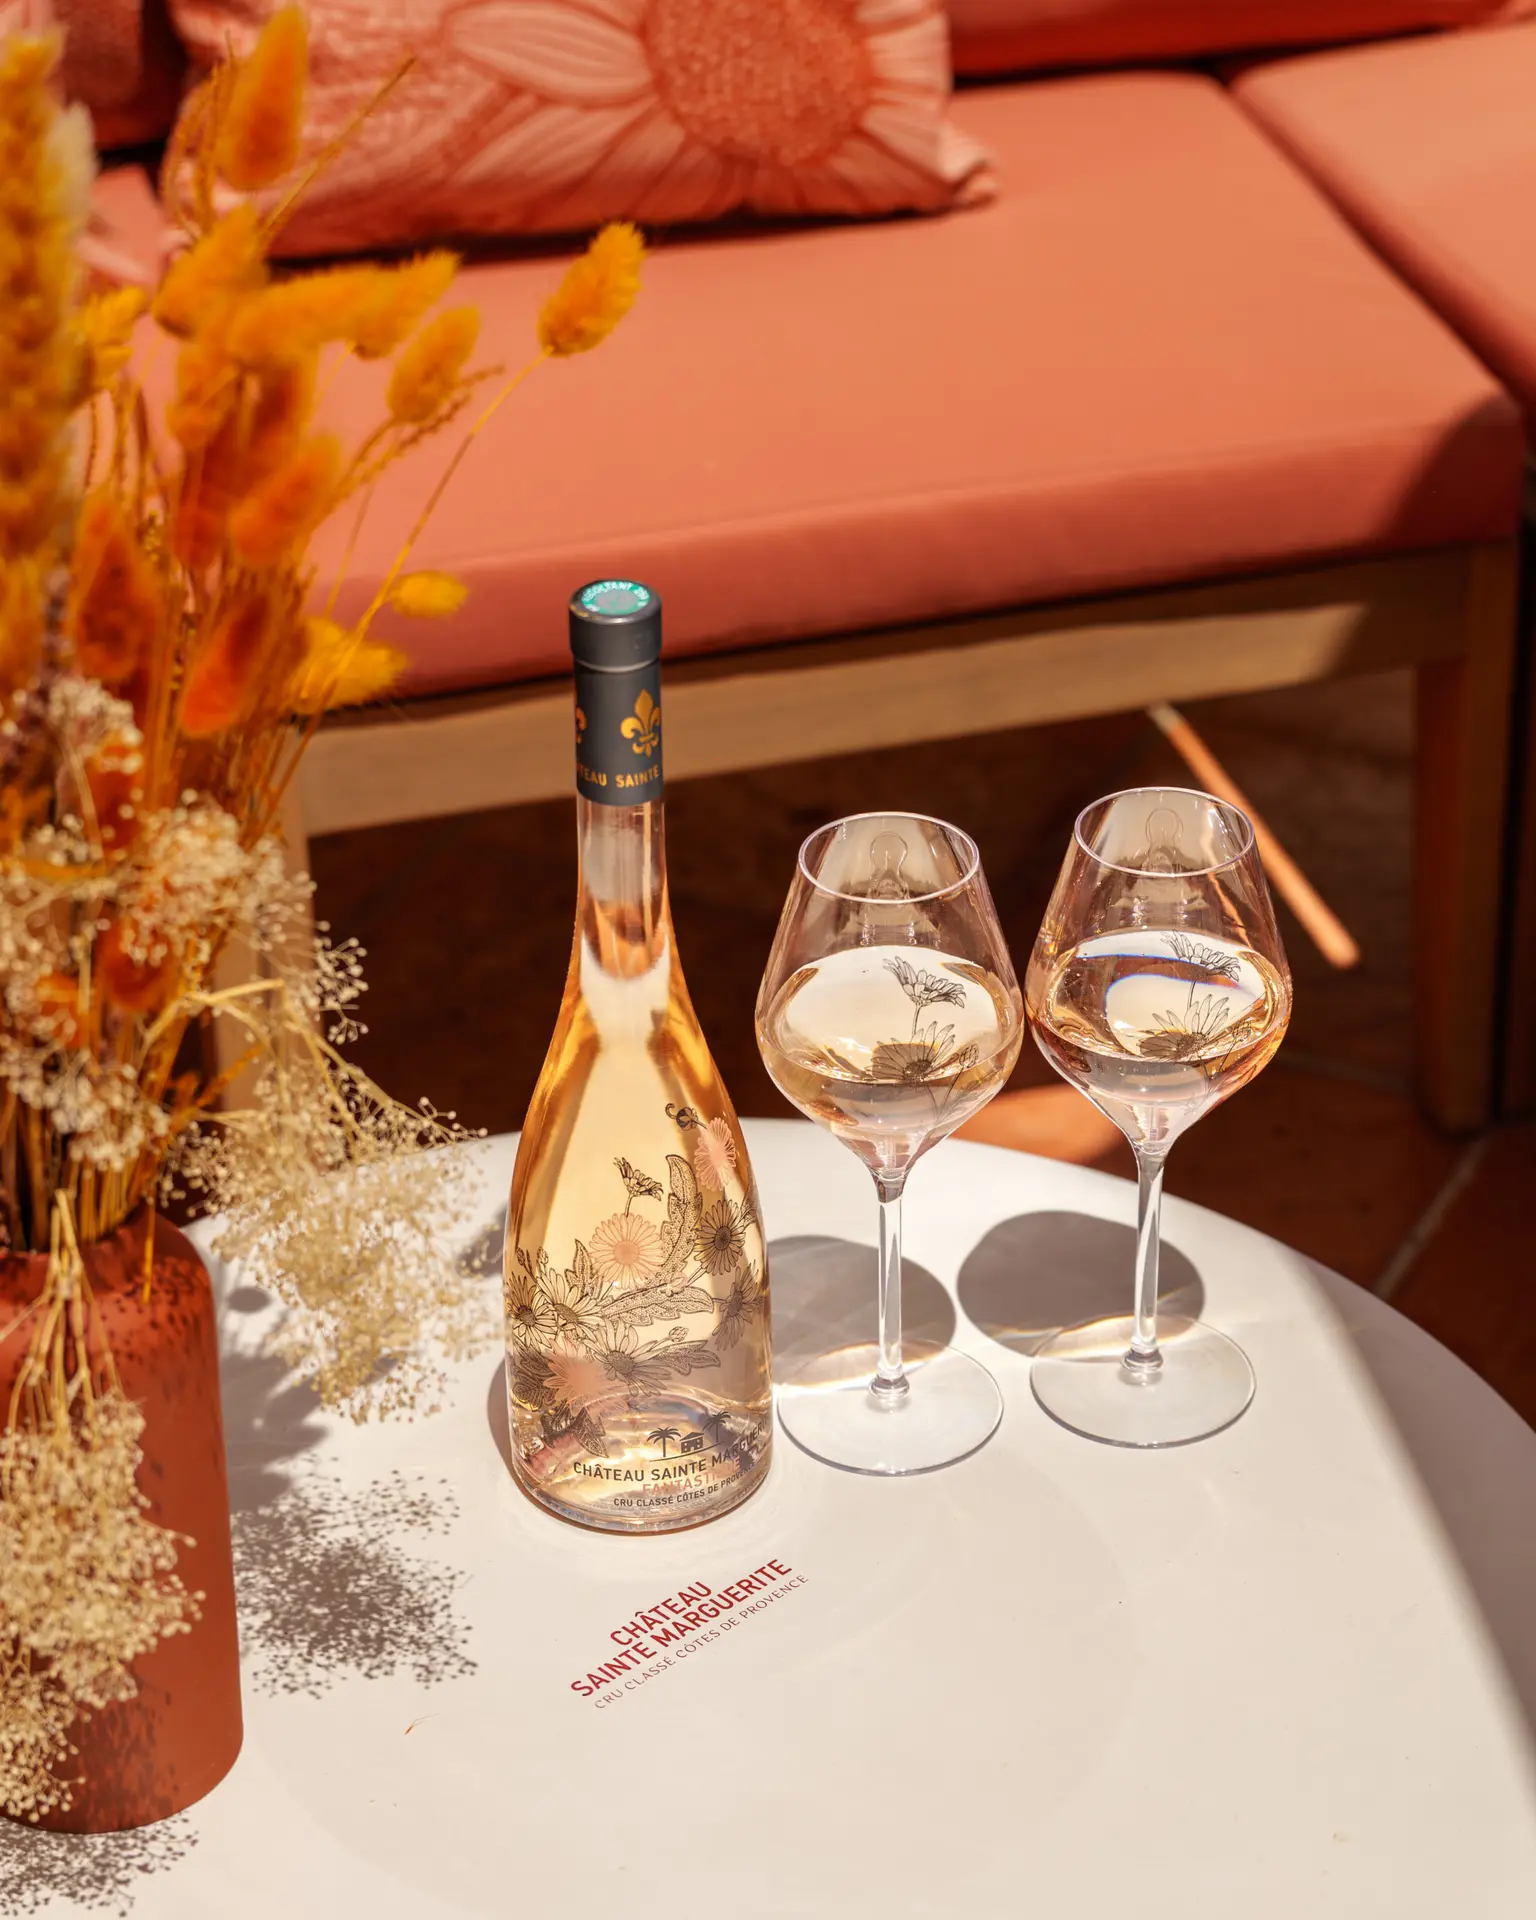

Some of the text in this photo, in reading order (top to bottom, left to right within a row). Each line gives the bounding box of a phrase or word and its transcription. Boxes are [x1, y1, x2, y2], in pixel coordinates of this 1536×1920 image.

[615, 764, 659, 788] SAINTE
[573, 1461, 645, 1482] CHÂTEAU
[651, 1458, 707, 1481] SAINTE
[642, 1456, 741, 1497] FANTASTIE
[613, 1498, 633, 1507] CRU
[636, 1495, 674, 1507] CLASSÉ
[676, 1488, 705, 1503] CÔTES
[708, 1484, 719, 1494] DE
[570, 1558, 793, 1698] SAINTE MARGUERITE
[609, 1581, 713, 1647] CHÂTEAU
[594, 1573, 809, 1709] CRU CLASSÉ CÔTES DE PROVENCE
